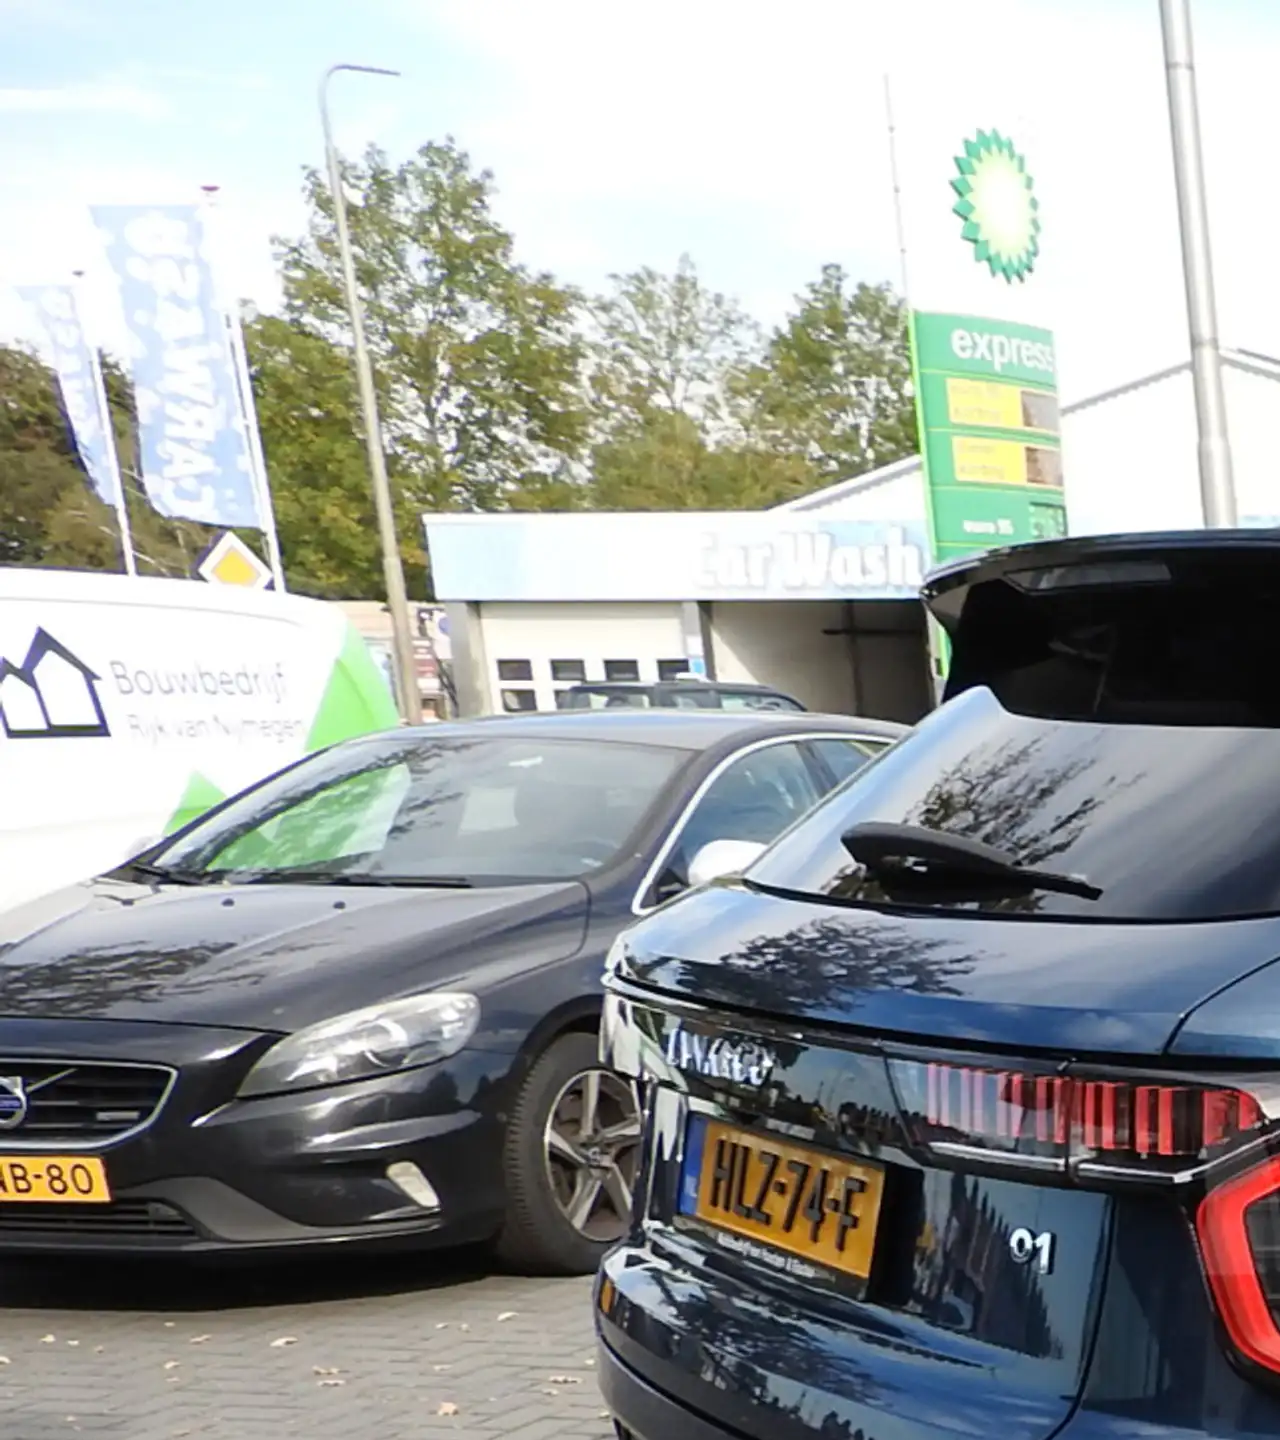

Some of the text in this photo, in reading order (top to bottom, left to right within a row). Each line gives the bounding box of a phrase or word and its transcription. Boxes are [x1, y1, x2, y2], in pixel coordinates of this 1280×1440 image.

[777, 525, 925, 591] Wash
[109, 660, 287, 704] Bouwbedrijf
[709, 1137, 868, 1253] HLZ-74-F
[1009, 1227, 1056, 1275] 01
